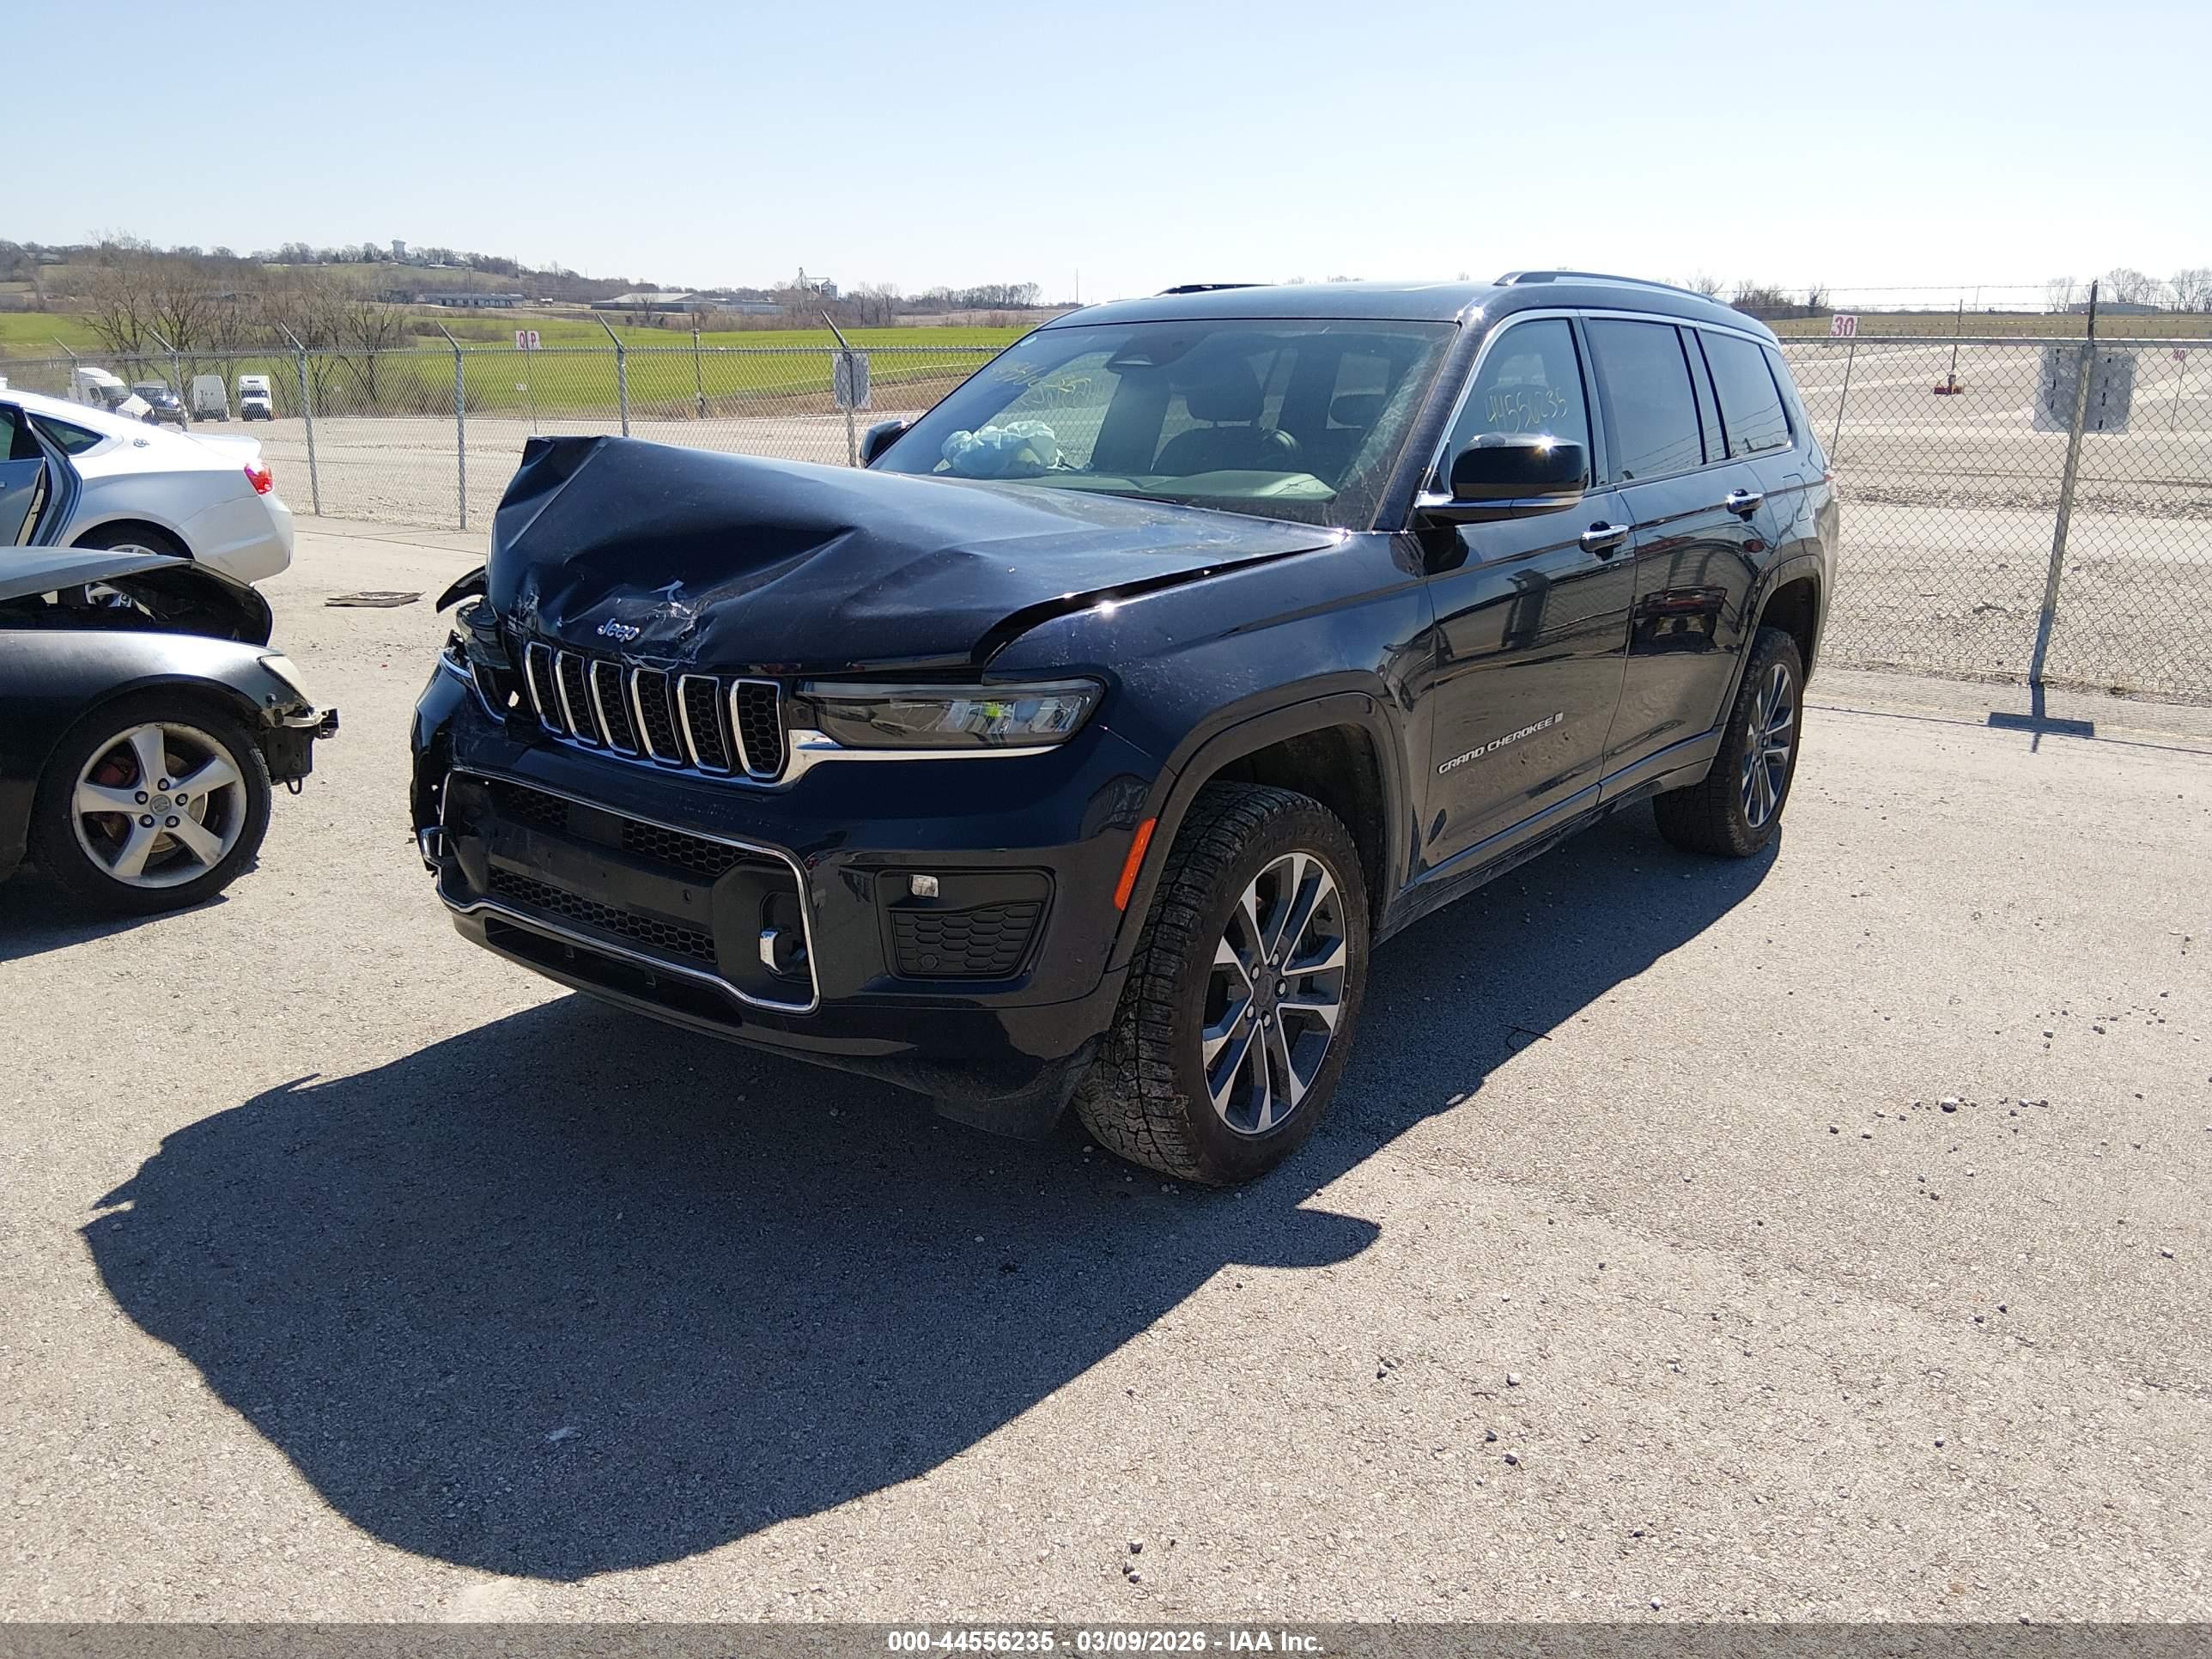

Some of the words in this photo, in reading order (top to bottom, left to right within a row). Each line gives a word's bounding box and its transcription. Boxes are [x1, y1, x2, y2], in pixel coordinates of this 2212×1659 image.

[1832, 316, 1855, 336] 30
[2172, 349, 2185, 361] 40
[597, 617, 640, 643] Jeep
[1438, 745, 1485, 775] GRAND
[1486, 716, 1553, 752] CHEROKEE
